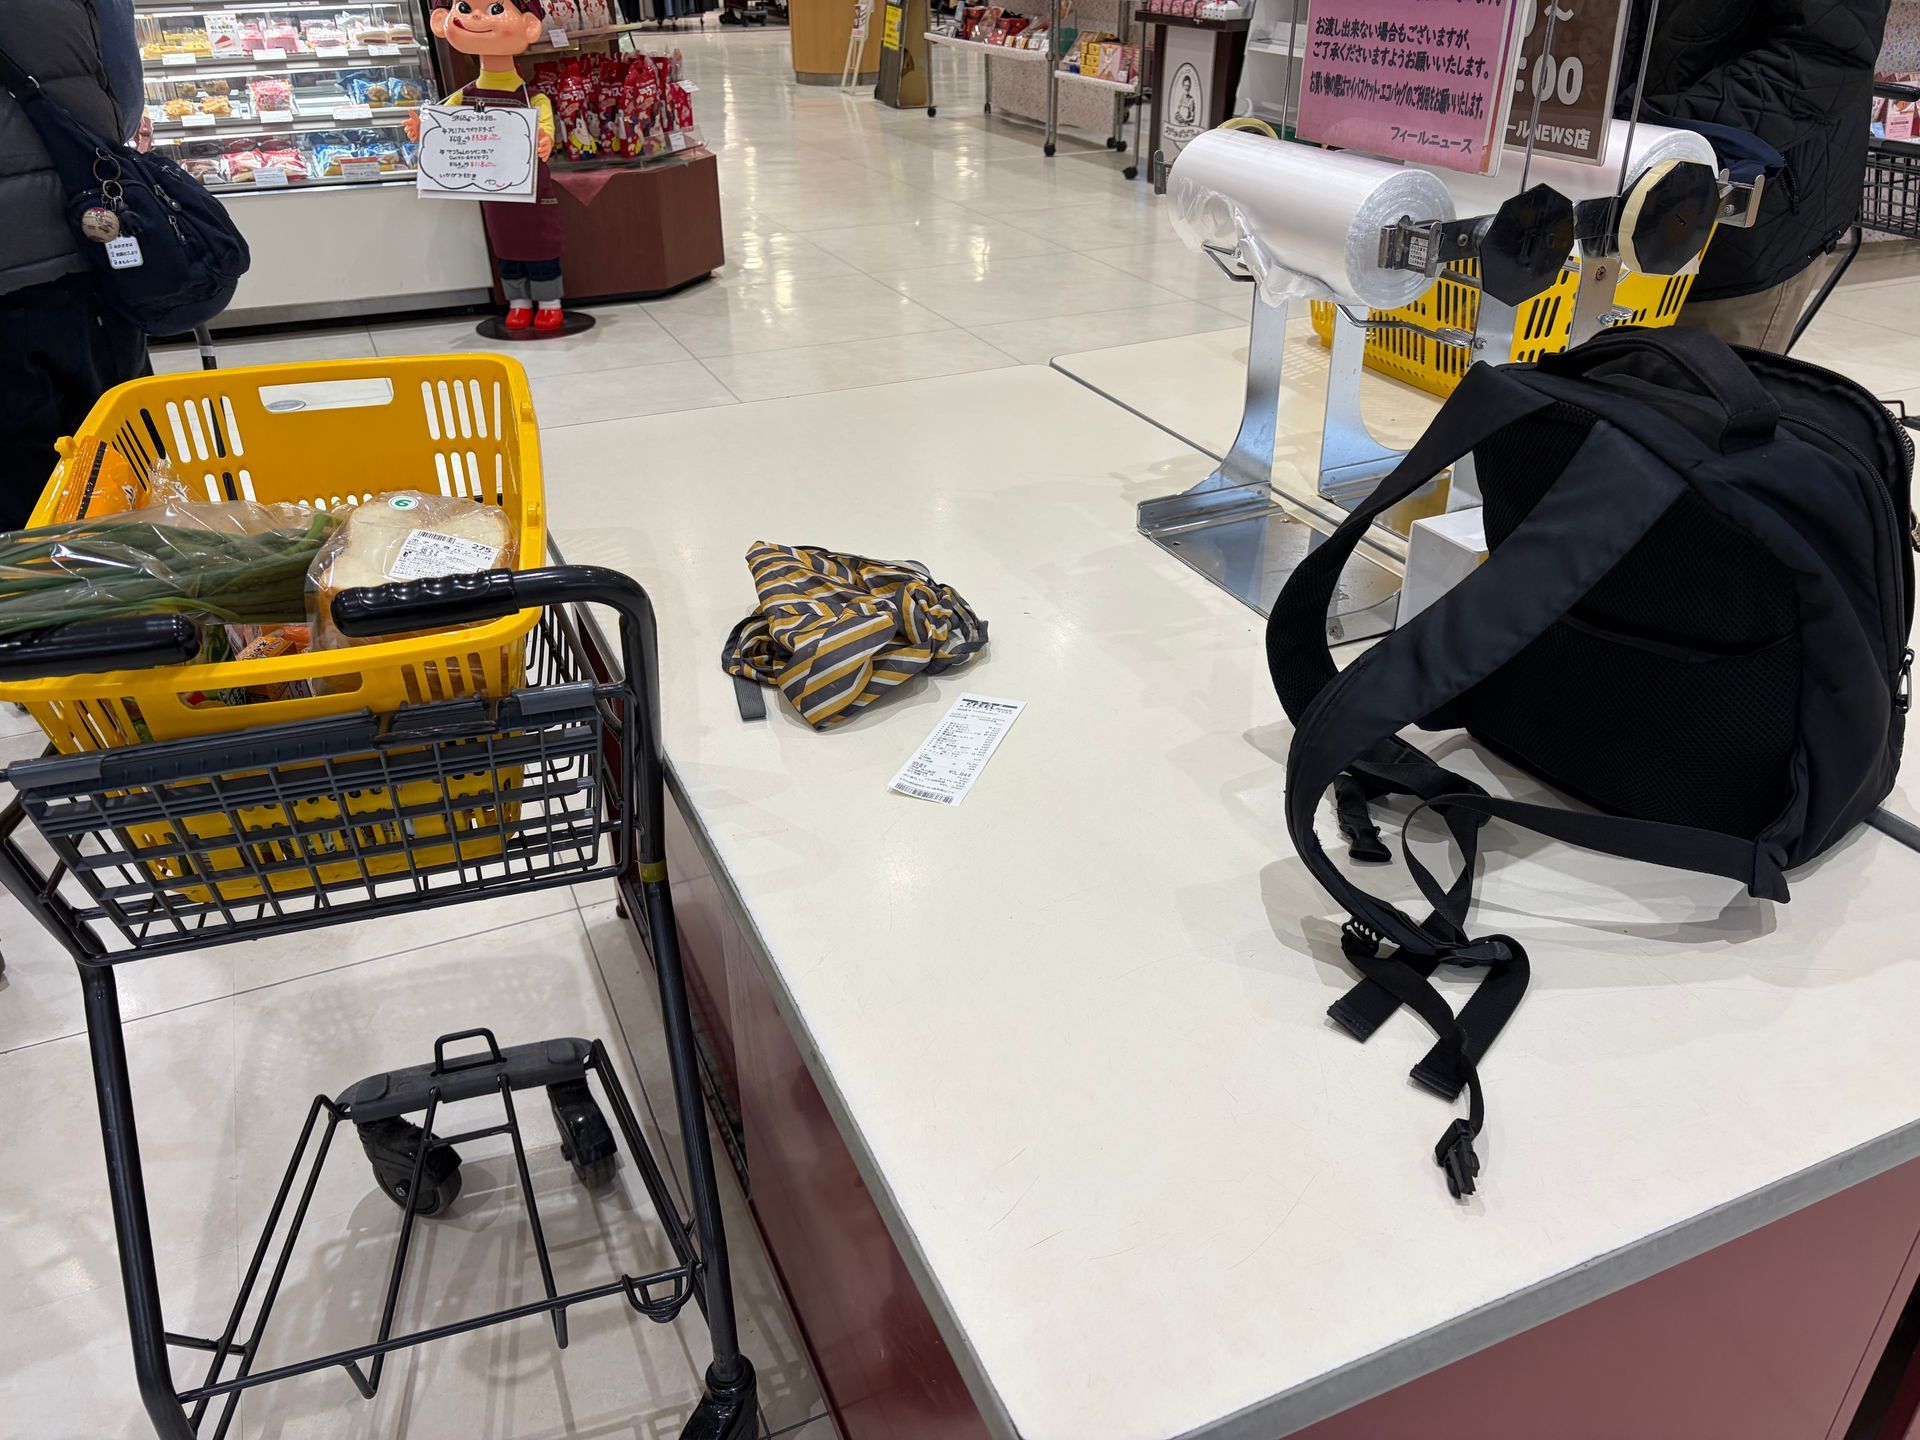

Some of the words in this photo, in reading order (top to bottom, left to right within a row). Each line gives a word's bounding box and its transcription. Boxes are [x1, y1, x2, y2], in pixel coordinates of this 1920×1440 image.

[1315, 16, 1470, 50] お渡し出来ない場合もございますが、
[1312, 40, 1489, 79] ご了承くださいますようお願いいたします。
[1391, 126, 1473, 154] フィールニュース
[394, 499, 412, 507] 6
